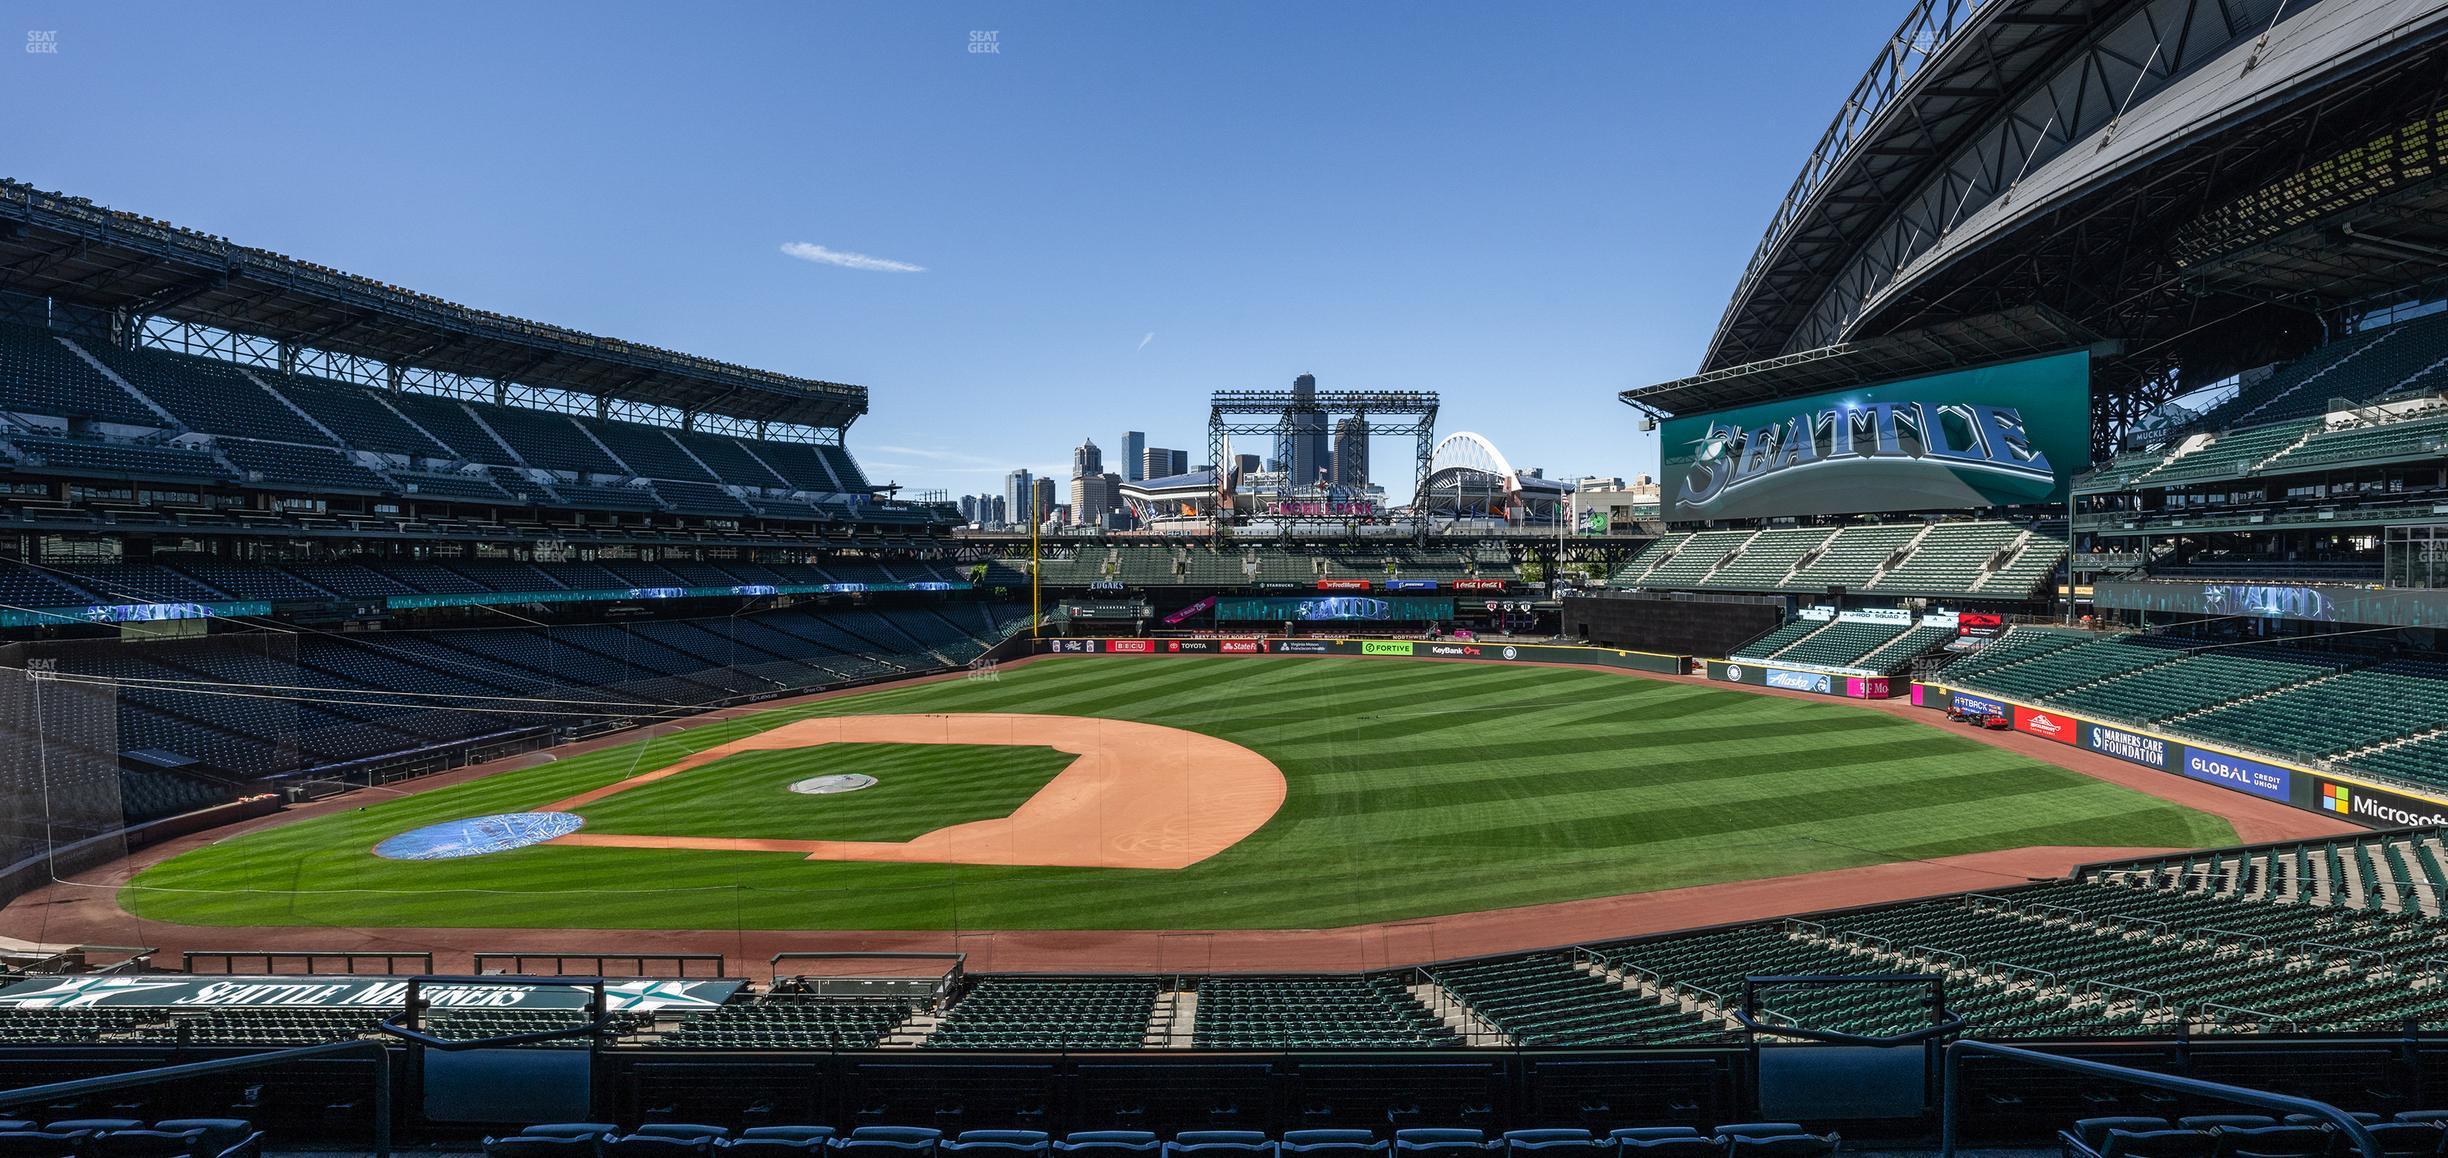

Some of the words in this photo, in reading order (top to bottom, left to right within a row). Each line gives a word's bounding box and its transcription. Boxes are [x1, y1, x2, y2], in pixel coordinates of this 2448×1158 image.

[2136, 428, 2168, 440] MUCKLE
[1675, 402, 2055, 508] SEATTLE
[1336, 502, 1372, 514] PARK
[1770, 673, 1808, 689] Alaska
[2105, 729, 2140, 747] MARINERS
[2143, 738, 2163, 753] CARE
[2104, 740, 2163, 766] FOUNDATION
[2192, 758, 2250, 783] GLOBAL
[2254, 773, 2280, 784] CREDIT
[2254, 781, 2278, 790] UNION
[173, 982, 351, 1004] SEATTLE
[336, 982, 536, 1006] MARINERS
